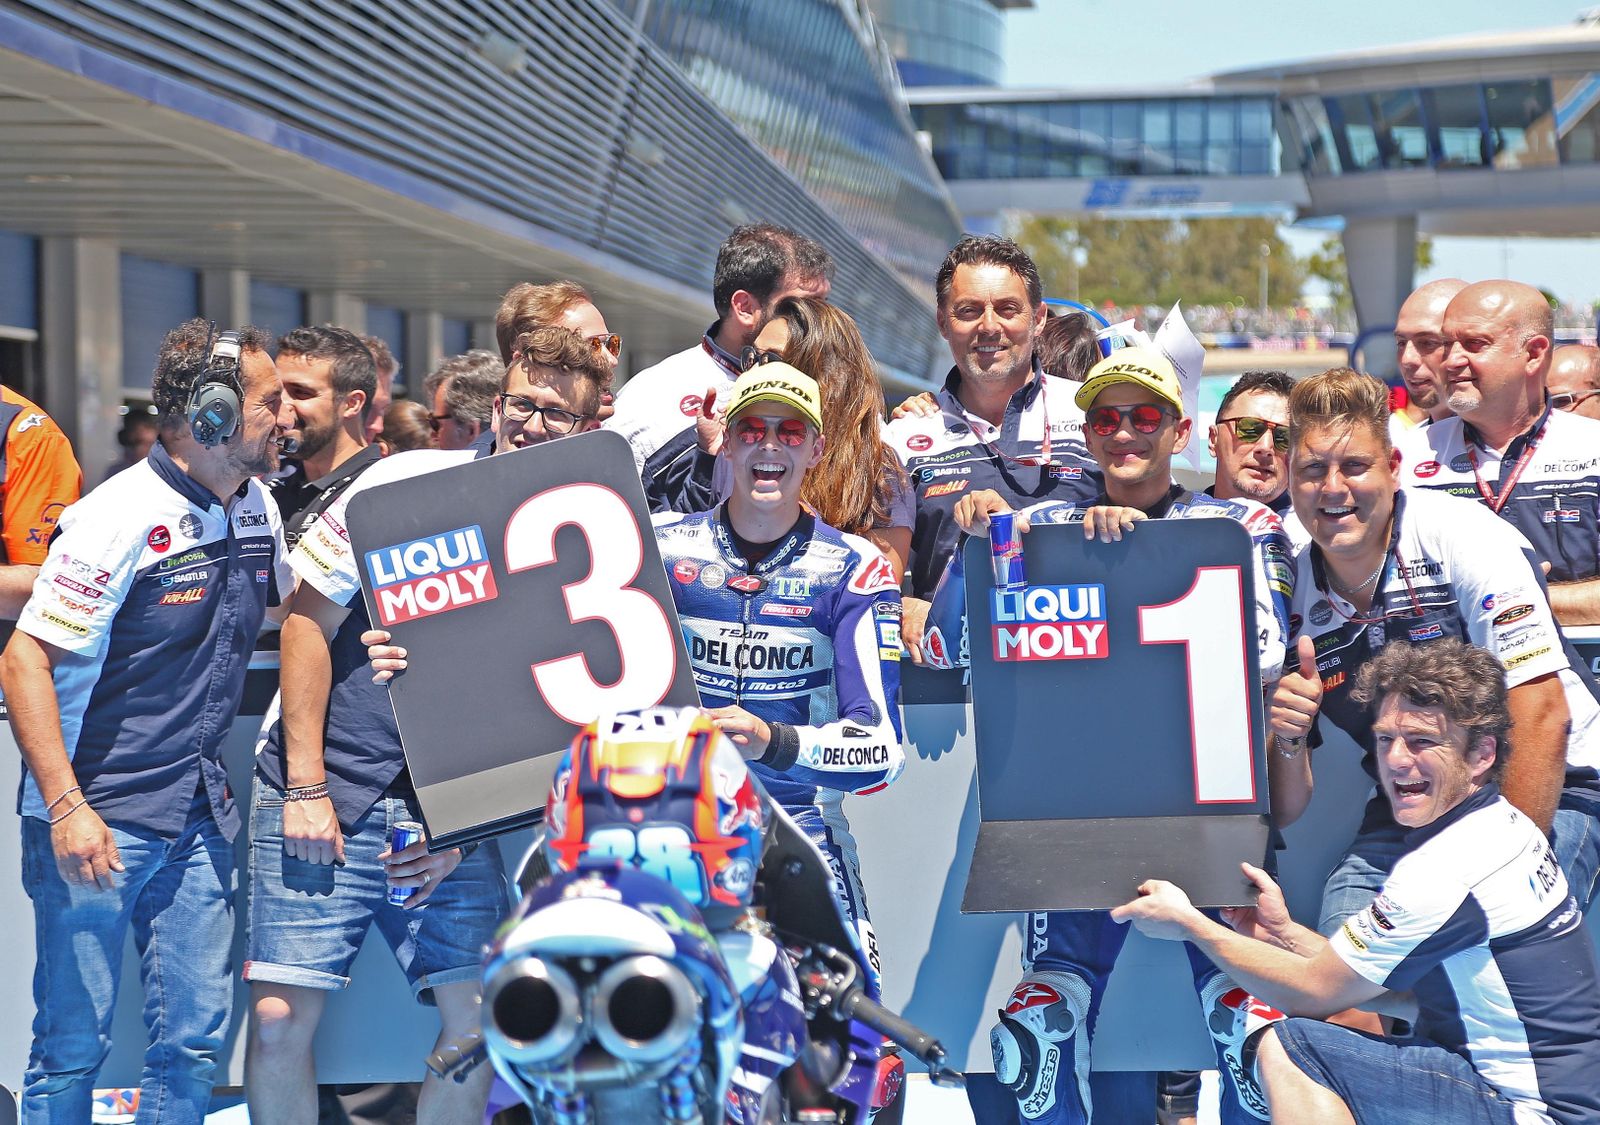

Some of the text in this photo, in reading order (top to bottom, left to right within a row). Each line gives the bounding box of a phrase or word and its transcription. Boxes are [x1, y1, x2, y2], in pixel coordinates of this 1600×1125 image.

[1102, 363, 1164, 383] NLOP
[739, 380, 813, 404] DUNLOP
[303, 546, 330, 570] DUNLOP
[370, 528, 484, 587] LIQUI
[380, 564, 489, 623] MOLY
[503, 481, 677, 729] 3
[995, 586, 1101, 623] LIQUI
[48, 615, 87, 632] DUNLOP
[719, 628, 769, 640] TEAM
[997, 624, 1105, 658] MOLY
[749, 678, 808, 691] Moto3
[1137, 565, 1257, 805] 1
